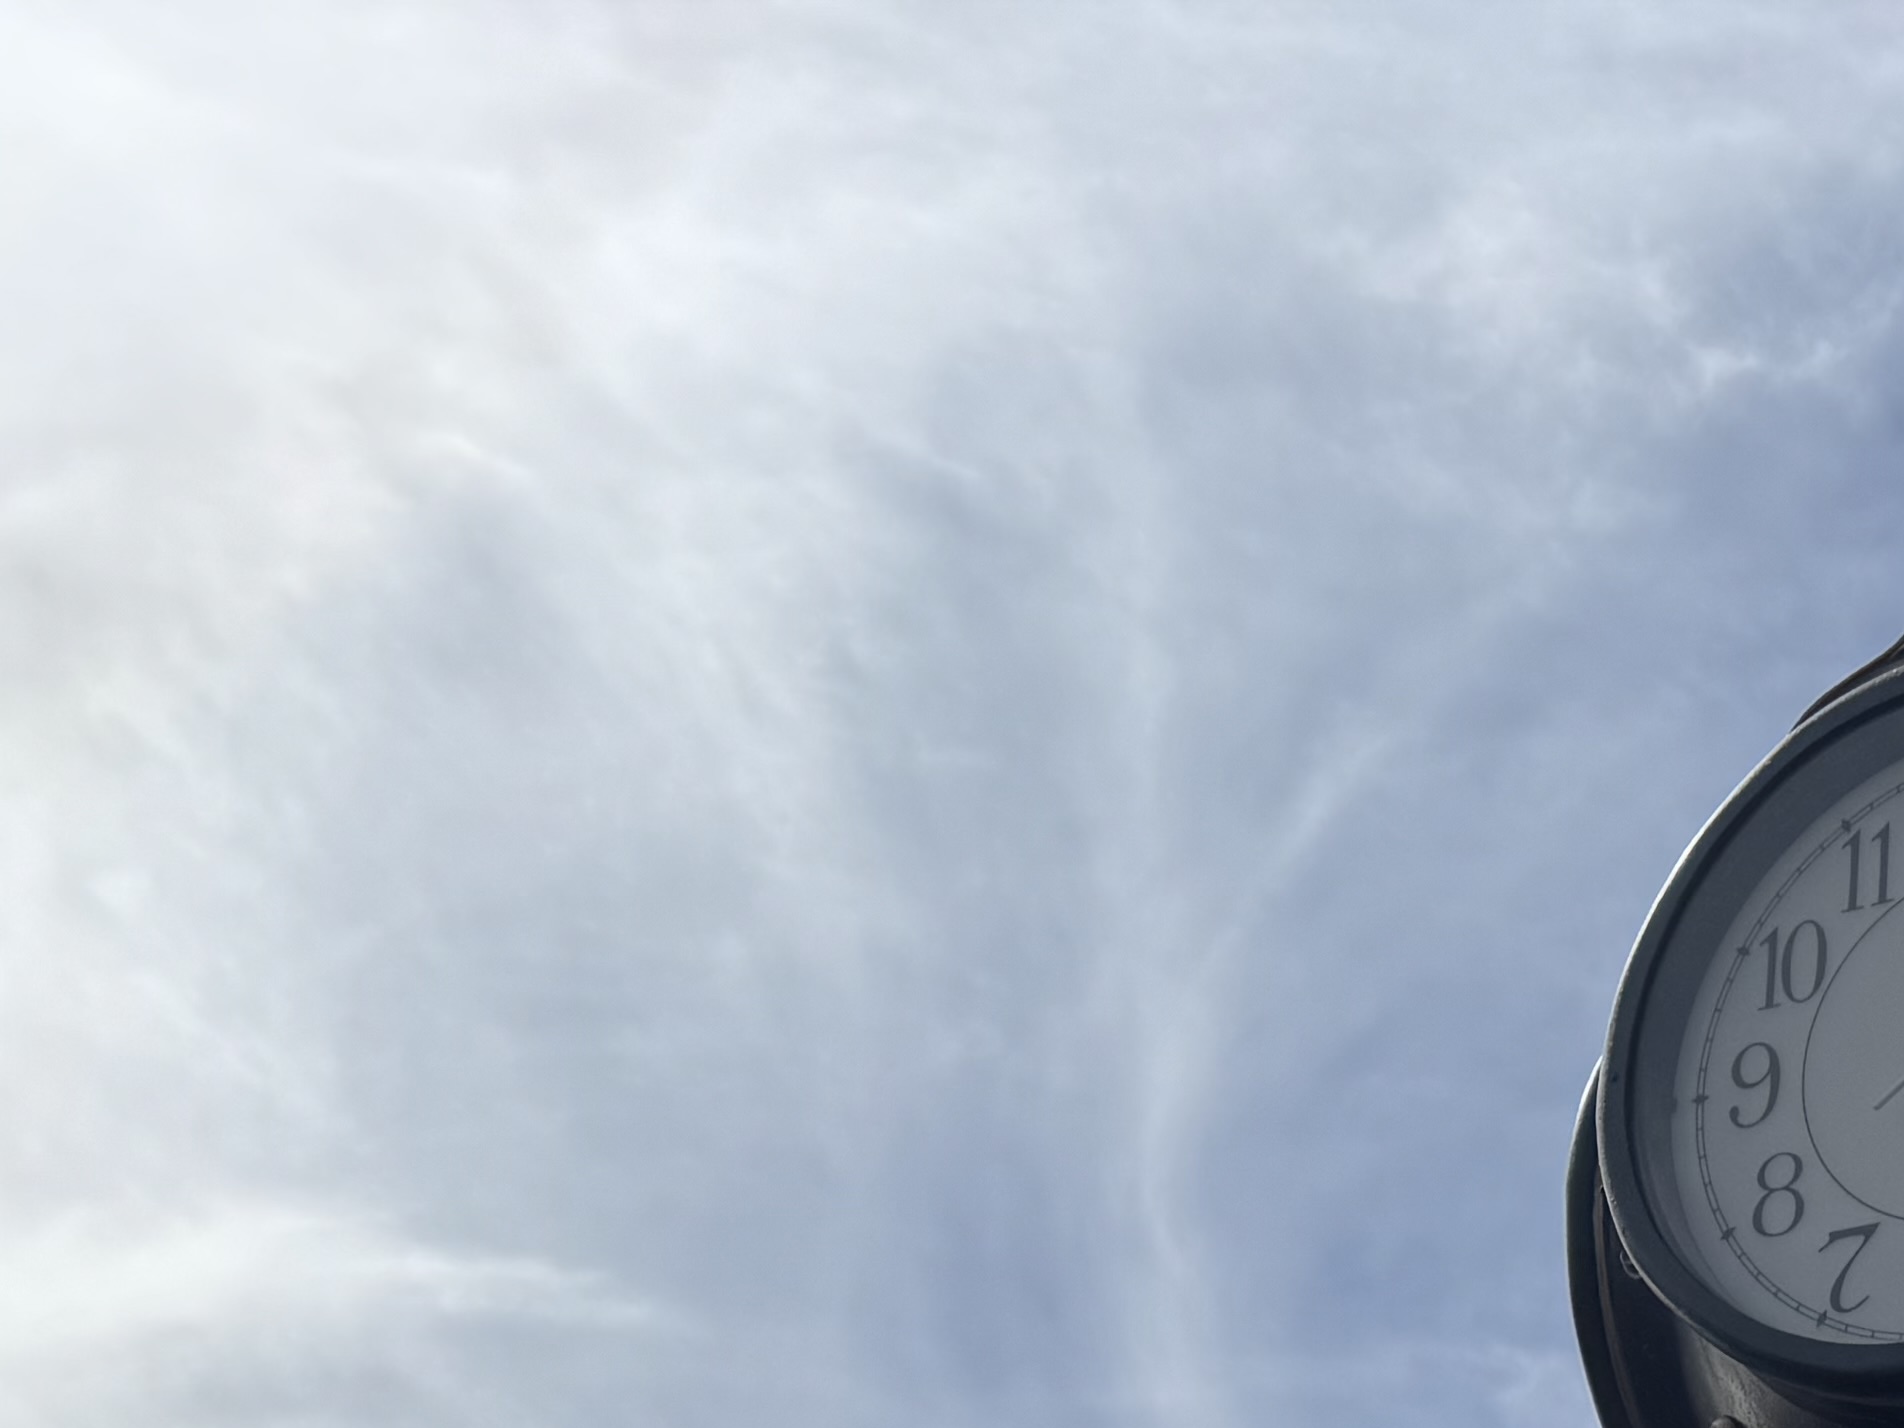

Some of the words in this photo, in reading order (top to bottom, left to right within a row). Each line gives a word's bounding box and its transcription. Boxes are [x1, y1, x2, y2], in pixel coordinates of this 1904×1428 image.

[1840, 820, 1896, 915] 11
[1757, 917, 1830, 1013] 10
[1729, 1041, 1782, 1130] 9
[1751, 1150, 1806, 1238] 8
[1818, 1222, 1881, 1314] 7
